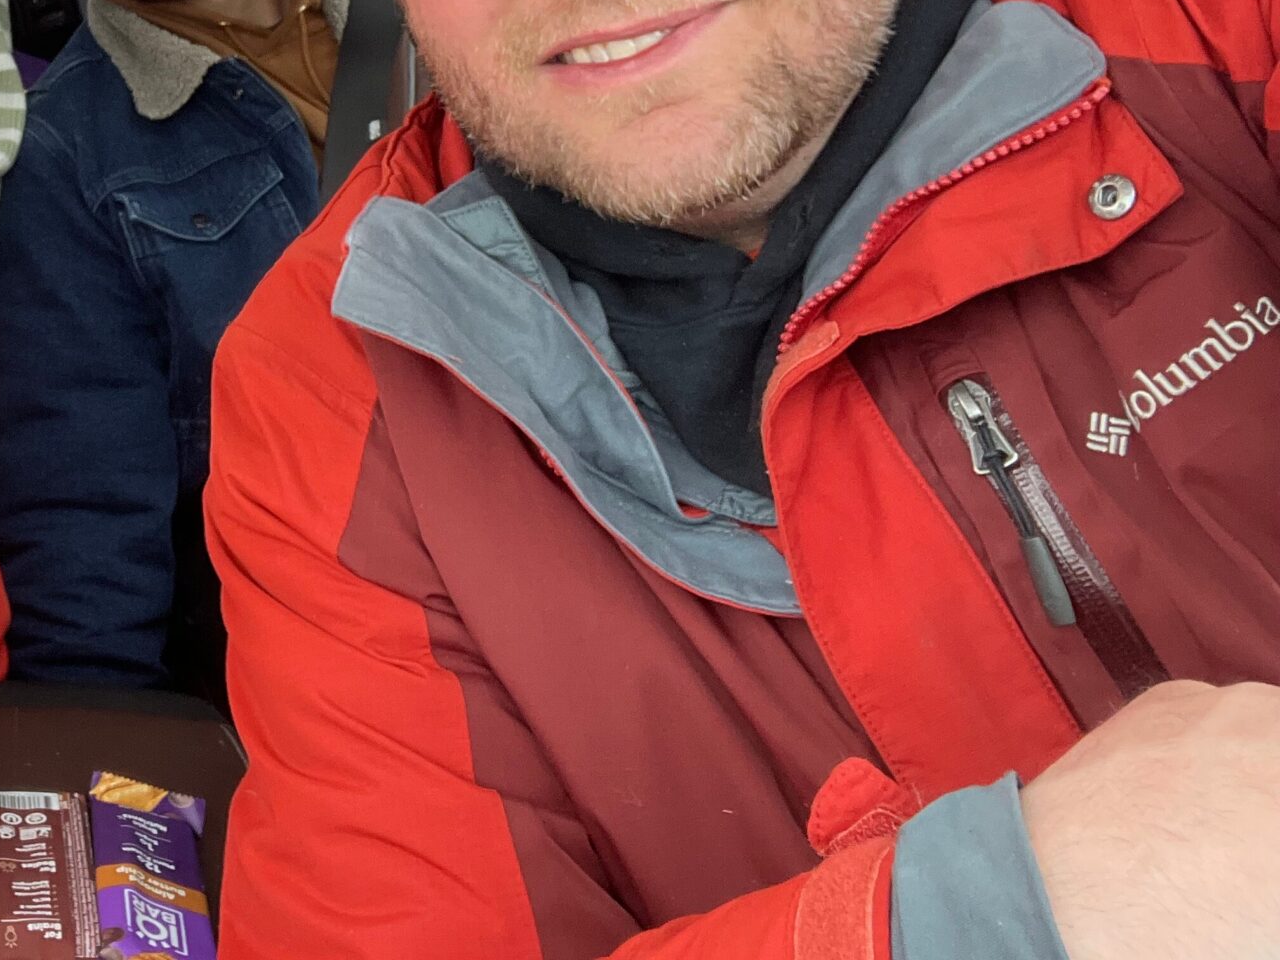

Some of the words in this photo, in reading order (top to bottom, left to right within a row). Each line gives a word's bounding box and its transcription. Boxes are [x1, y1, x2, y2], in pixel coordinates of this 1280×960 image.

[115, 865, 145, 882] Chip
[129, 874, 175, 900] Almond
[132, 895, 176, 925] BAR
[27, 922, 62, 932] Brains
[43, 930, 62, 939] For
